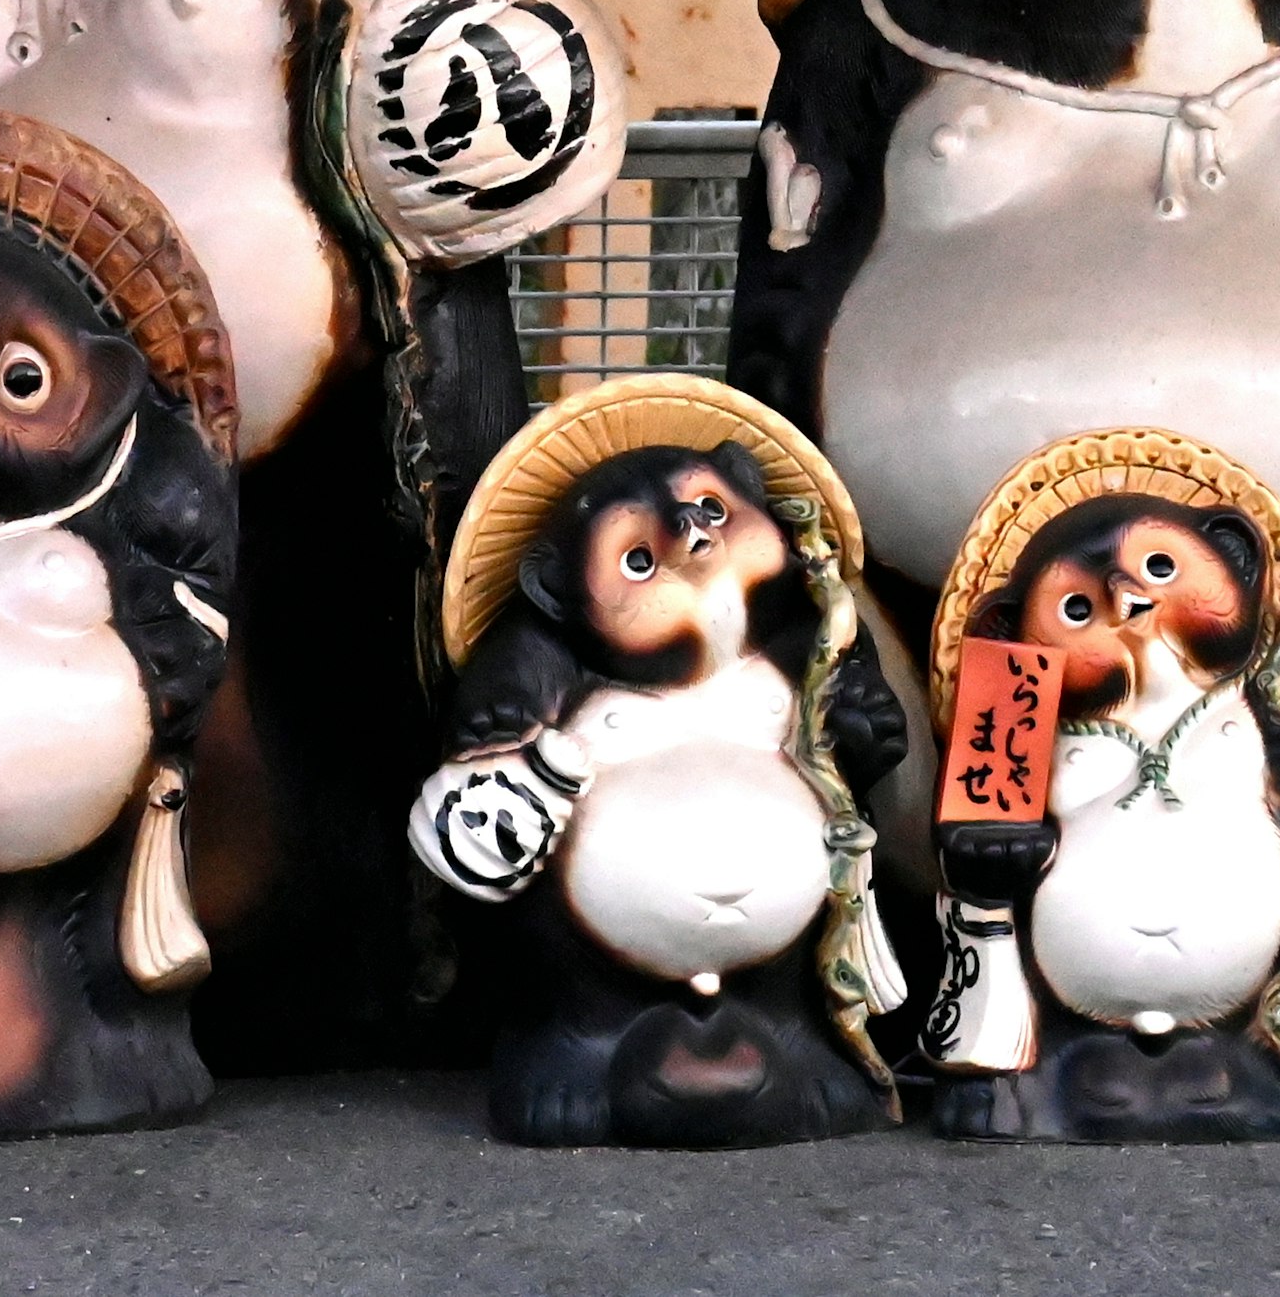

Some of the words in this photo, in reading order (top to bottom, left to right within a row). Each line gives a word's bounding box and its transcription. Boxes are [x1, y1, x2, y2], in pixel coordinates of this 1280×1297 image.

[956, 705, 997, 805] ませ
[996, 653, 1049, 813] いらっしゃい
